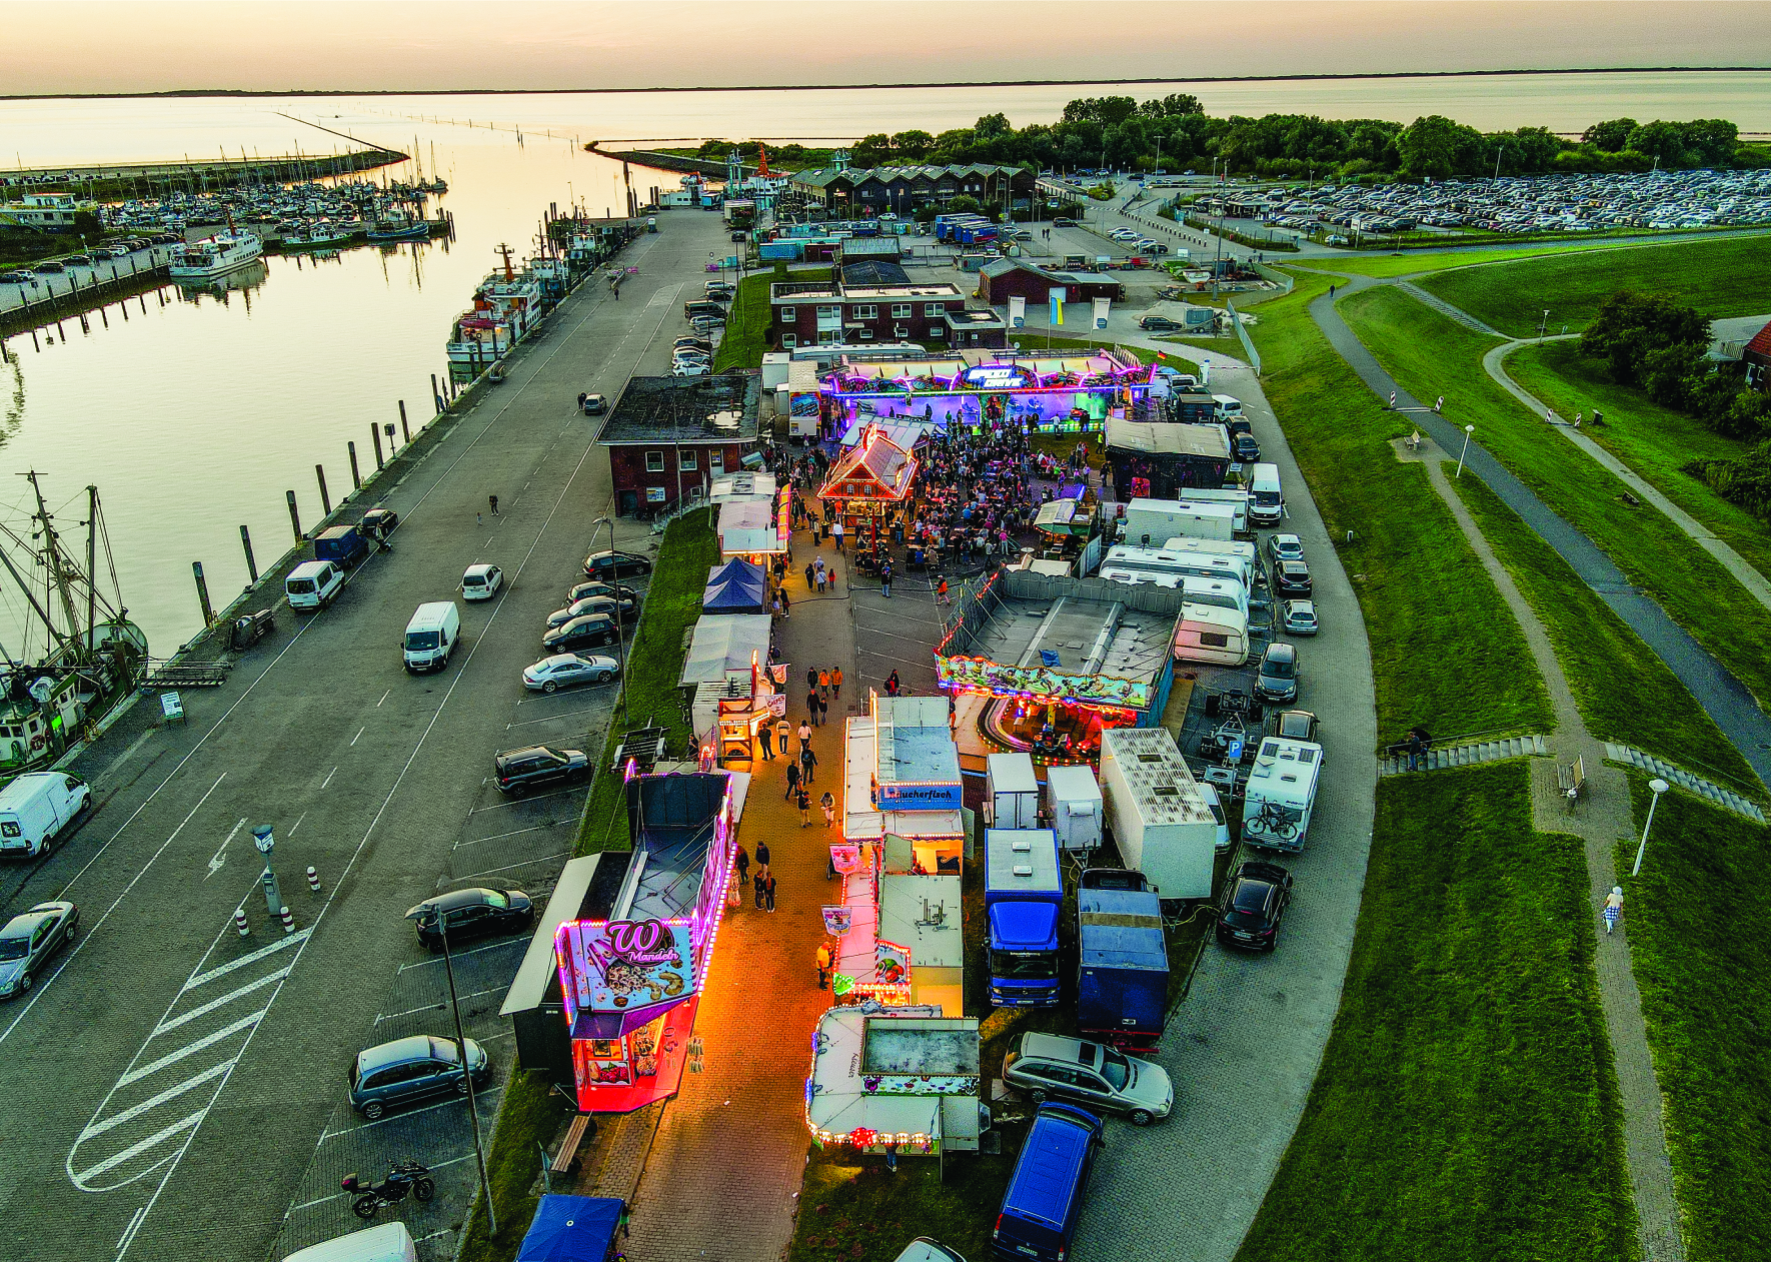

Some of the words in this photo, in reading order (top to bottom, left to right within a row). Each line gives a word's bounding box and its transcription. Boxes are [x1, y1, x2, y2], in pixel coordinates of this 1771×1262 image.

[1232, 742, 1239, 753] P
[608, 922, 660, 953] W
[628, 948, 680, 963] Mandeln
